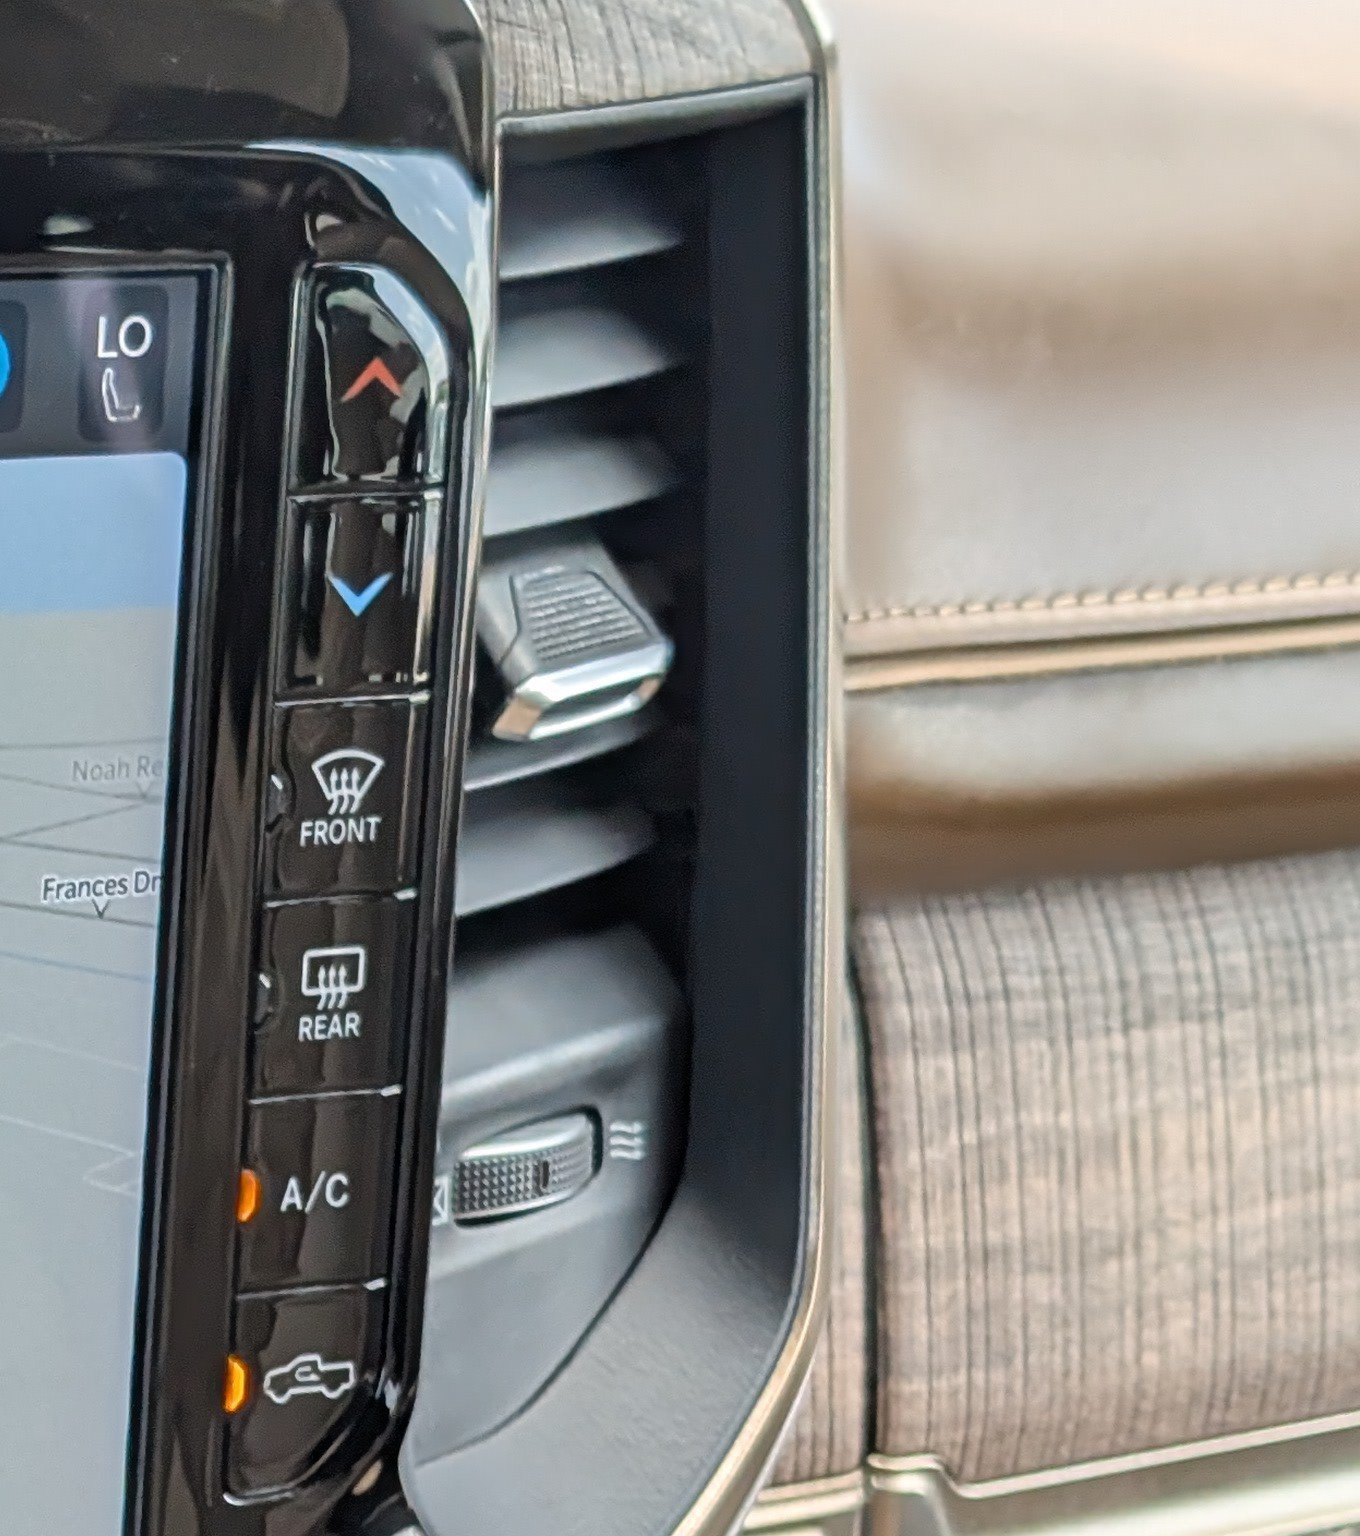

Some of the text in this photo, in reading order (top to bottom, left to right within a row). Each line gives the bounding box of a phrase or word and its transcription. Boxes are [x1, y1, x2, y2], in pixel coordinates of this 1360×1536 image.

[97, 316, 152, 358] LO
[73, 757, 130, 781] Noah
[300, 818, 380, 845] FRONT
[43, 877, 128, 900] Frances
[298, 1015, 361, 1041] REAR
[281, 1174, 350, 1212] A/C
